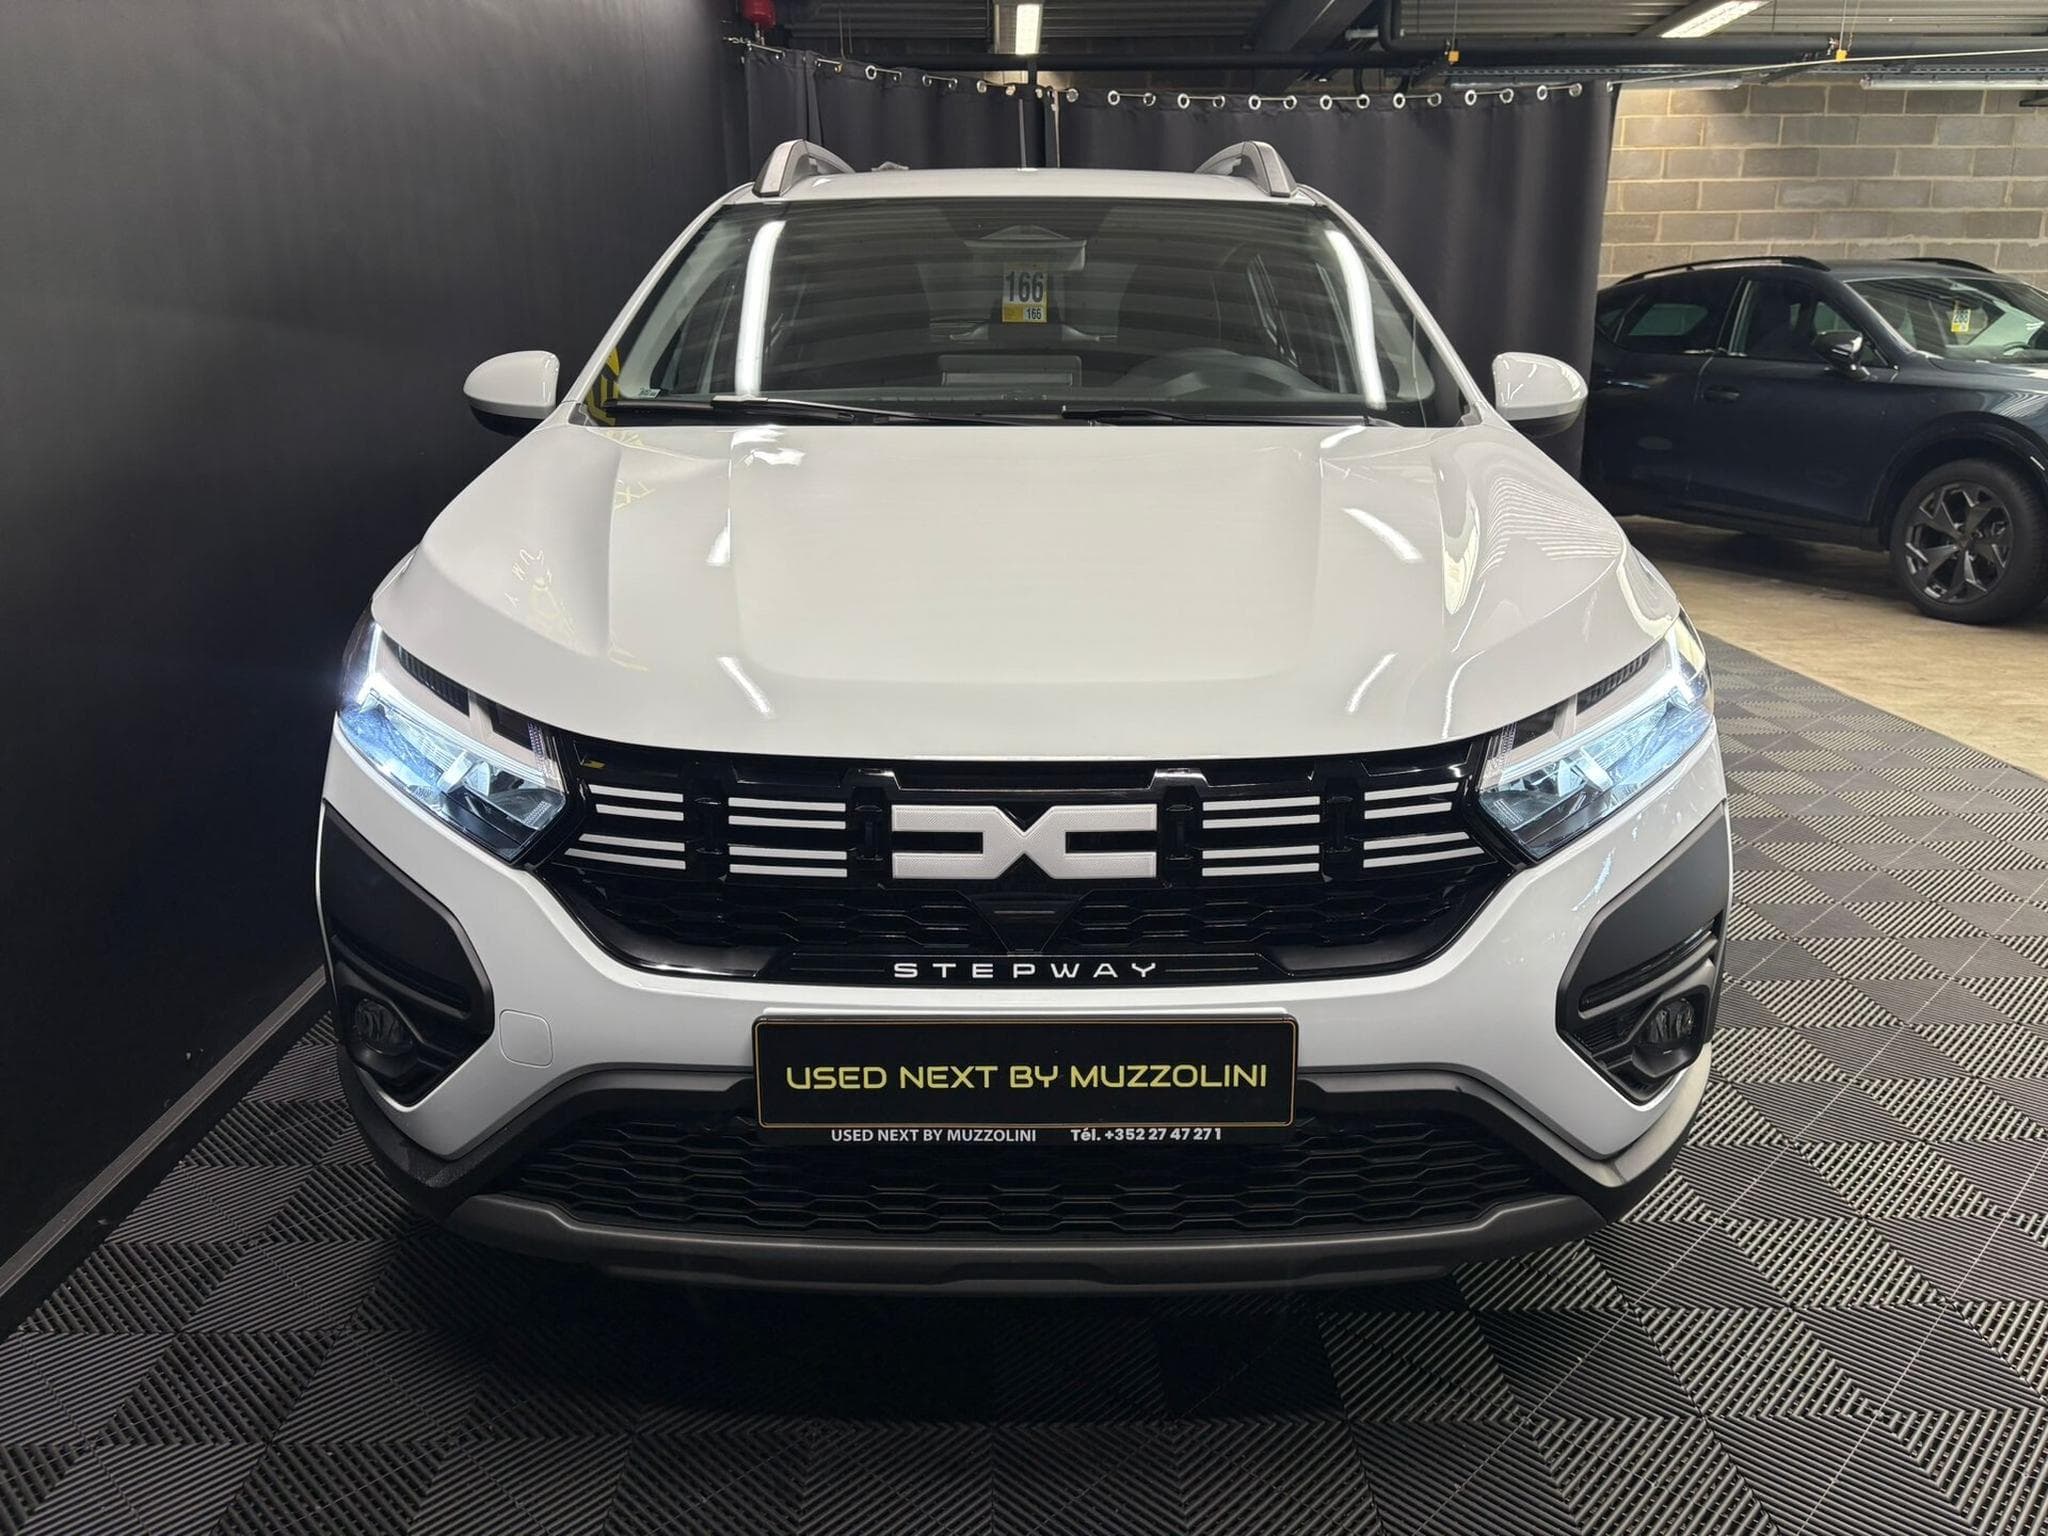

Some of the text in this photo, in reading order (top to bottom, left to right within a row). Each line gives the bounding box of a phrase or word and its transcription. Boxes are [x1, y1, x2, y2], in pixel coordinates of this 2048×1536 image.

[1005, 271, 1044, 303] 166
[1026, 308, 1042, 320] 166
[894, 962, 1156, 979] STEPWAY
[787, 1064, 1267, 1090] USED NEXT BY MUZZOLINI
[831, 1129, 1036, 1142] USED NEXT BY MUZZOLINI
[1070, 1127, 1101, 1142] Tél.
[1105, 1127, 1145, 1141] +352
[1148, 1127, 1167, 1141] 27
[1169, 1127, 1190, 1141] 47
